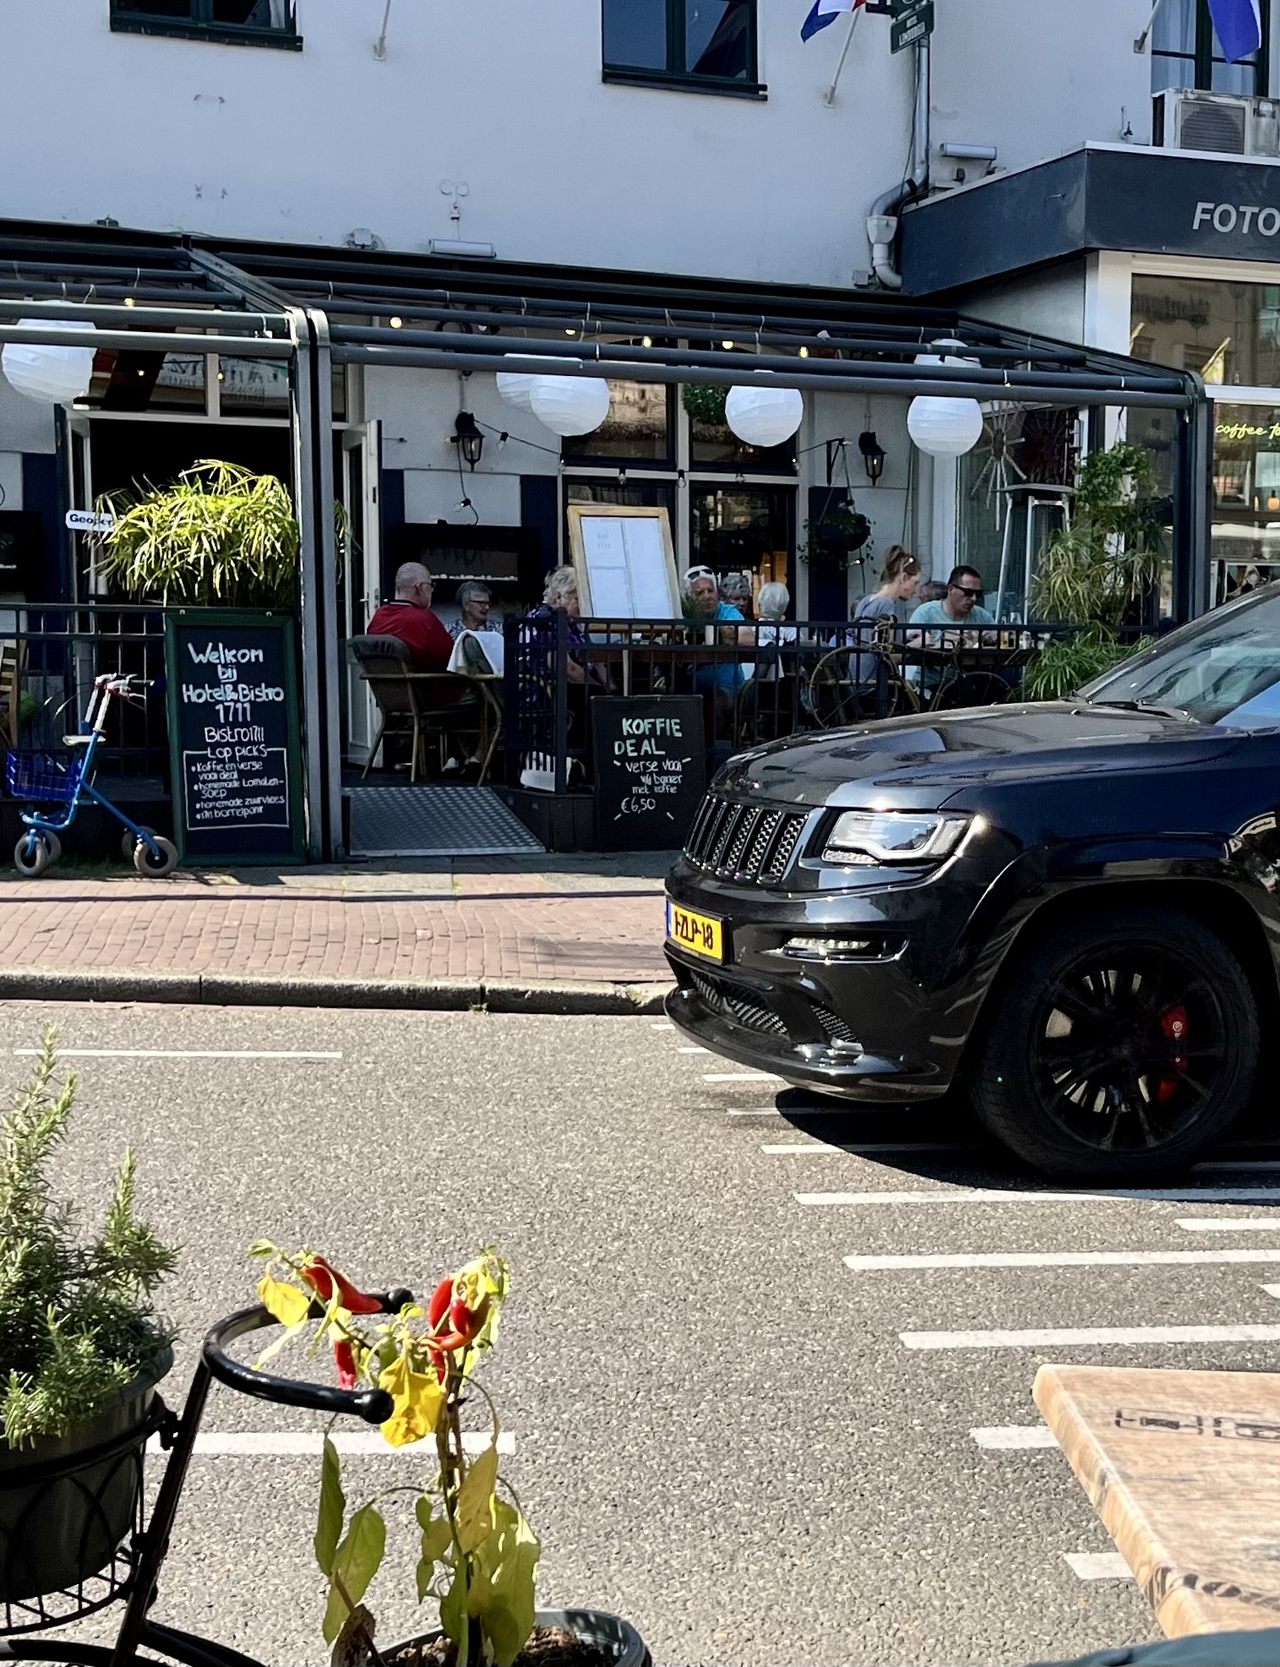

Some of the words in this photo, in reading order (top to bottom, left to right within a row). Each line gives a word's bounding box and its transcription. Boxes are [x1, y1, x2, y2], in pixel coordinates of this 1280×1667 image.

[1215, 423, 1268, 439] coffee
[187, 642, 264, 664] Welkom
[217, 664, 238, 683] bij
[215, 701, 251, 723] 1711
[622, 718, 682, 737] KOFFIE
[614, 738, 666, 757] DEAL
[236, 760, 263, 771] verse
[625, 760, 659, 773] verse
[219, 770, 238, 780] deal
[200, 788, 228, 800] soep
[632, 785, 650, 795] met
[653, 784, 678, 794] koffie
[620, 796, 656, 814] €6,50
[674, 909, 714, 951] 1-ZLP-18
